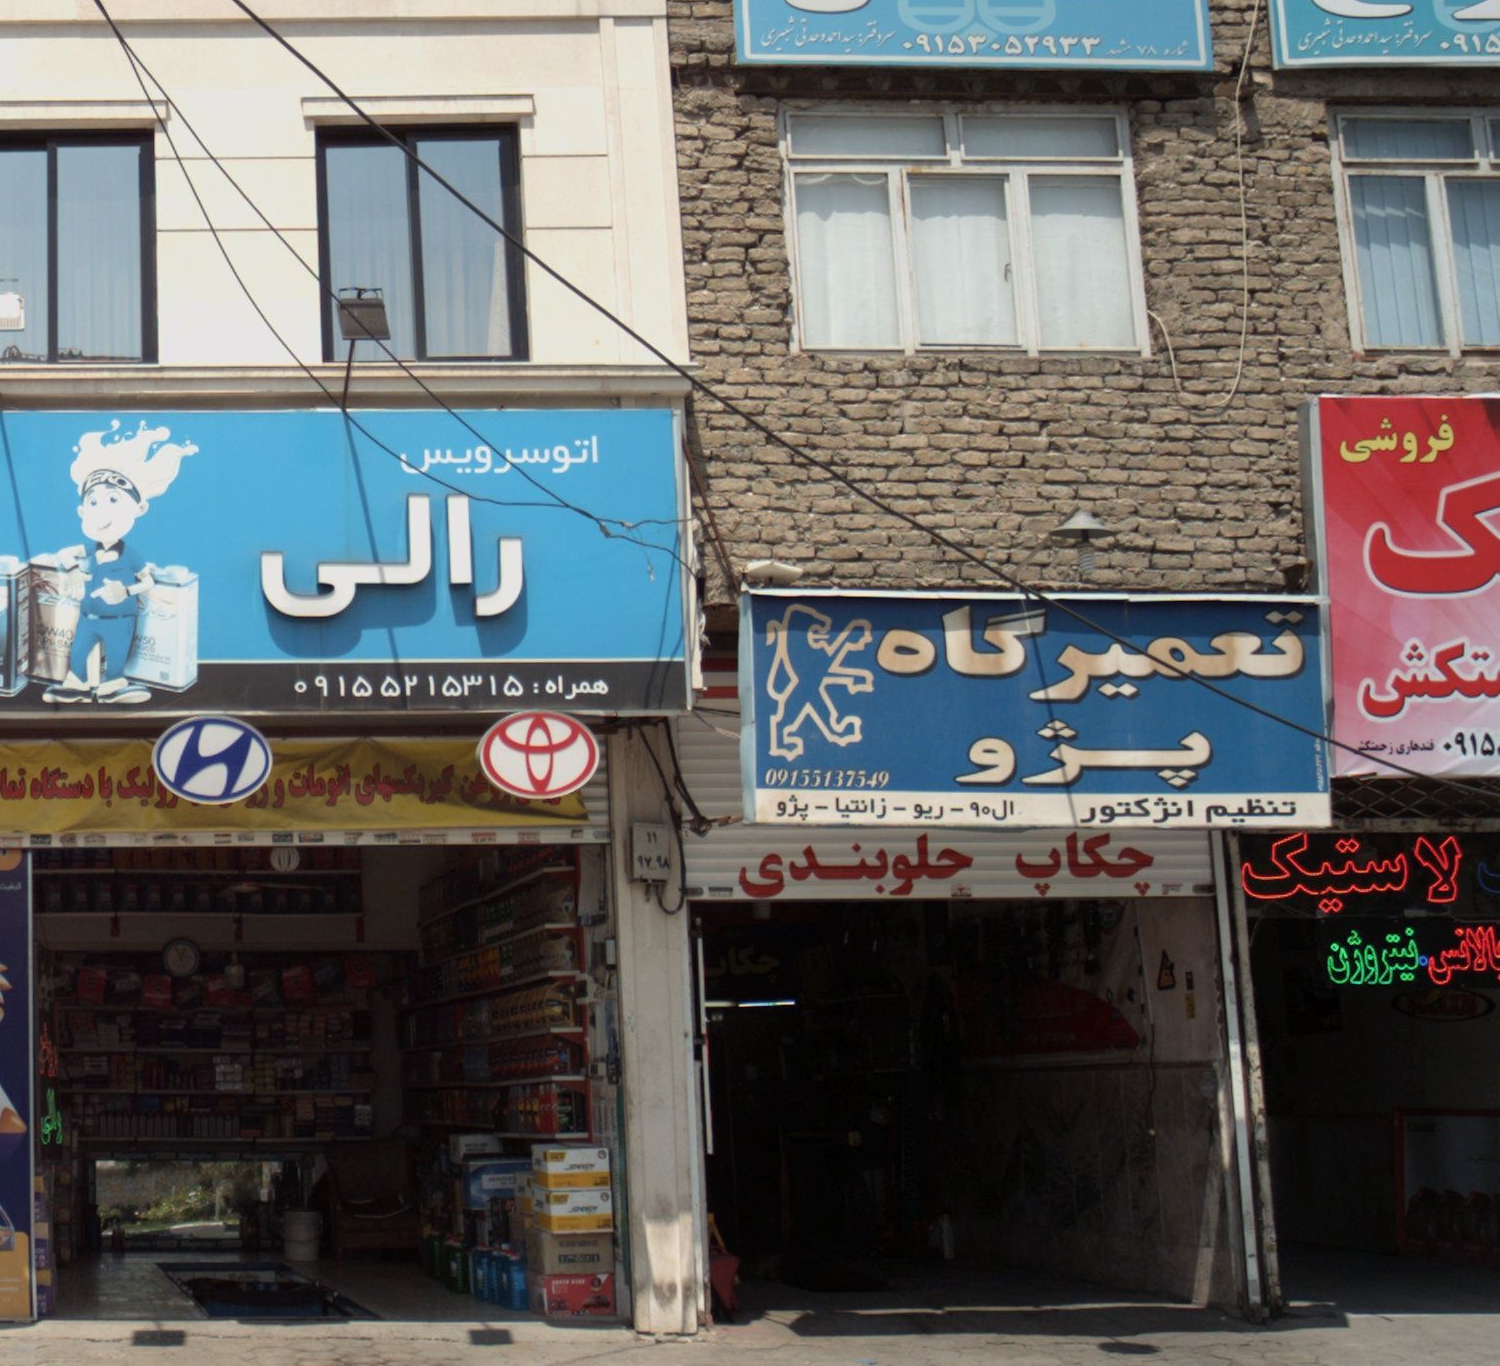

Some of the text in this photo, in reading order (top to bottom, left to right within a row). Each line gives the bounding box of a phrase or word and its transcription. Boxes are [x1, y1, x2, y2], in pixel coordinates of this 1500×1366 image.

[902, 33, 1101, 56] ۰۹۱۵۳۰۵۲۹۳۳
[1339, 413, 1455, 463] فروشی
[400, 435, 599, 474] اتوسرویس
[259, 493, 524, 618] رالی
[875, 605, 1308, 703] تعمیرگاه
[294, 675, 524, 698] ۰۹۱۵۵۲۱۵۳۱۵
[954, 718, 1213, 790] پژو
[1443, 731, 1500, 756] ۰۹۱۵
[30, 766, 95, 799] دستگاه
[764, 769, 890, 788] 09155137549
[776, 794, 809, 821] پژو
[835, 795, 887, 819] زانتیا
[913, 801, 944, 820] ریو
[1080, 797, 1194, 823] انژکتور
[1205, 798, 1297, 823] تنظیم
[1015, 831, 1155, 896] چکاپ
[1327, 927, 1420, 986] نیتروژن
